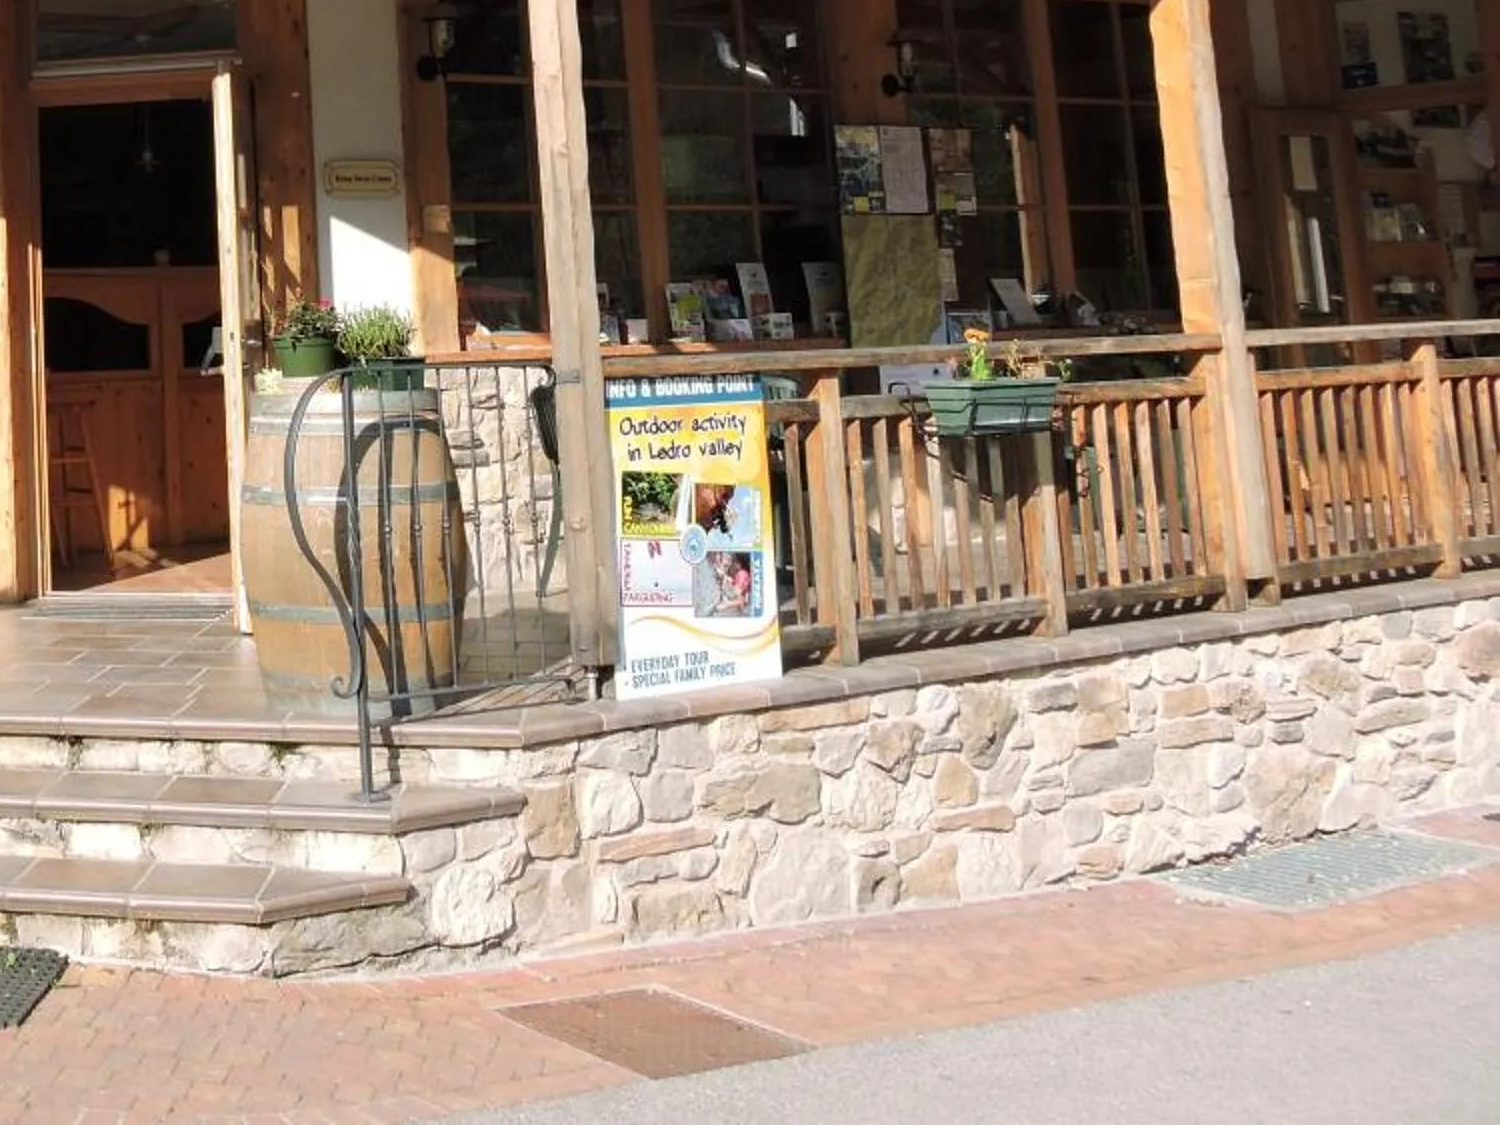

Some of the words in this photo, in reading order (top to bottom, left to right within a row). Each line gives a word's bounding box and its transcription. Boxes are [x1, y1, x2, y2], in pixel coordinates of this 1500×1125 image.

[655, 376, 713, 396] BOOKING
[717, 375, 754, 394] POINT
[619, 416, 683, 436] Outdoor
[691, 412, 747, 435] activity
[627, 442, 642, 461] in
[648, 439, 691, 460] Ledro
[699, 438, 743, 460] valley
[631, 654, 680, 674] EVERYDAY
[684, 651, 710, 666] TOUR
[631, 673, 671, 689] SPECIAL
[674, 666, 707, 683] FAMILY
